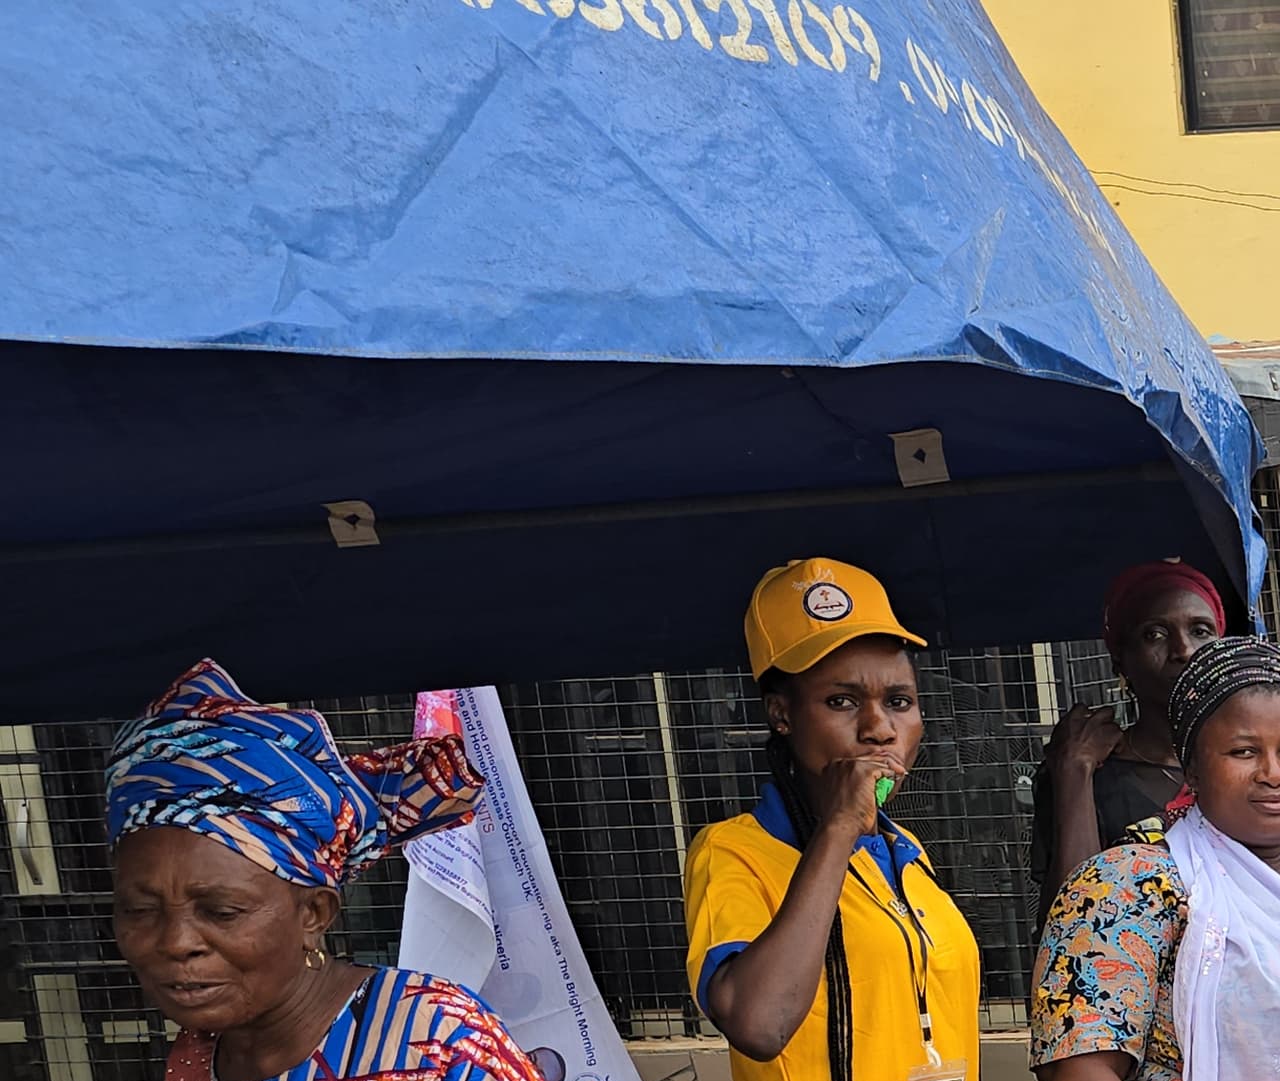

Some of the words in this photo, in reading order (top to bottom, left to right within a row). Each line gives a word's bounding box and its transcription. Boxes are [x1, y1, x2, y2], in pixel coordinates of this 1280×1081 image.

[461, 710, 476, 732] and
[470, 733, 504, 821] Homelessness
[500, 822, 524, 877] Outreach
[521, 880, 534, 902] UK.
[475, 719, 488, 742] and
[482, 743, 506, 800] prisoners
[503, 799, 522, 846] support
[518, 847, 545, 911] foundation
[550, 935, 562, 956] aka
[557, 957, 571, 980] The
[566, 981, 584, 1020] Bright
[576, 1018, 597, 1067] Morning
